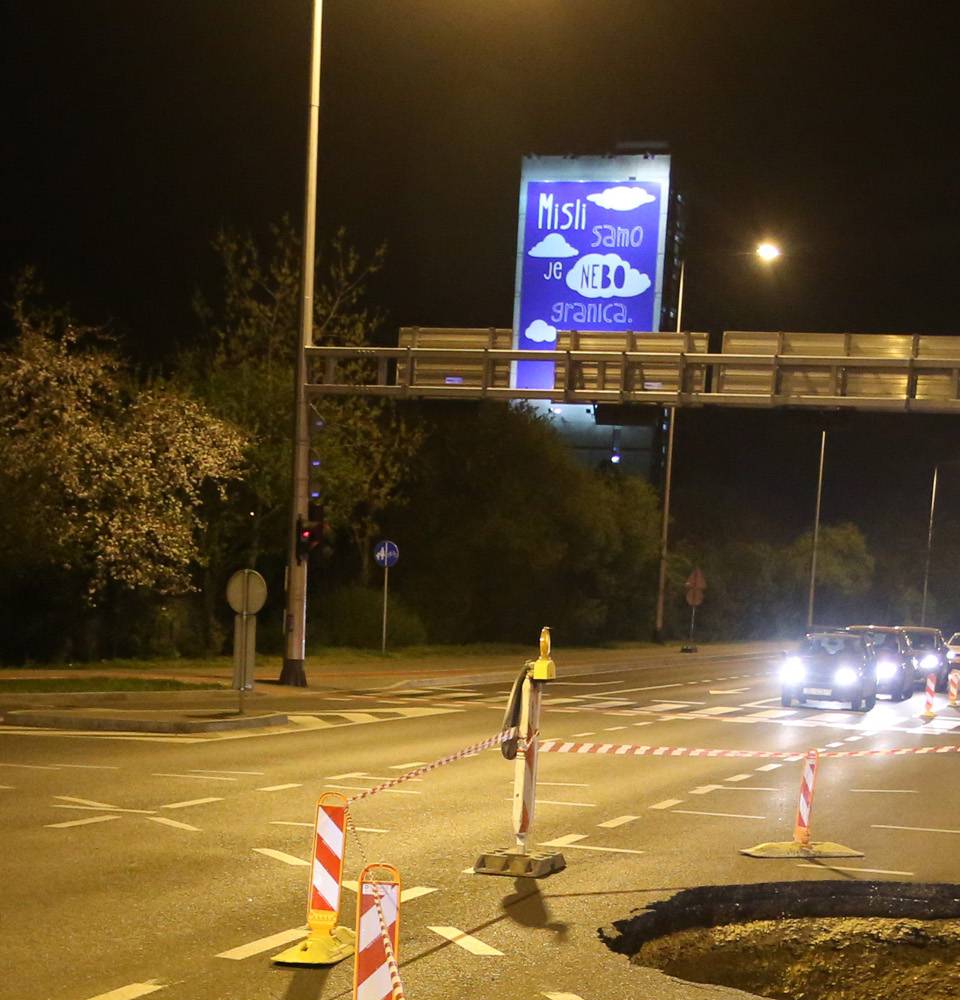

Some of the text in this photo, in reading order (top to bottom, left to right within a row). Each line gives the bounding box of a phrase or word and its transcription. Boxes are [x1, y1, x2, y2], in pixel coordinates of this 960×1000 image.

[538, 193, 587, 230] Misli
[591, 224, 644, 248] samo
[580, 264, 625, 289] NEBO
